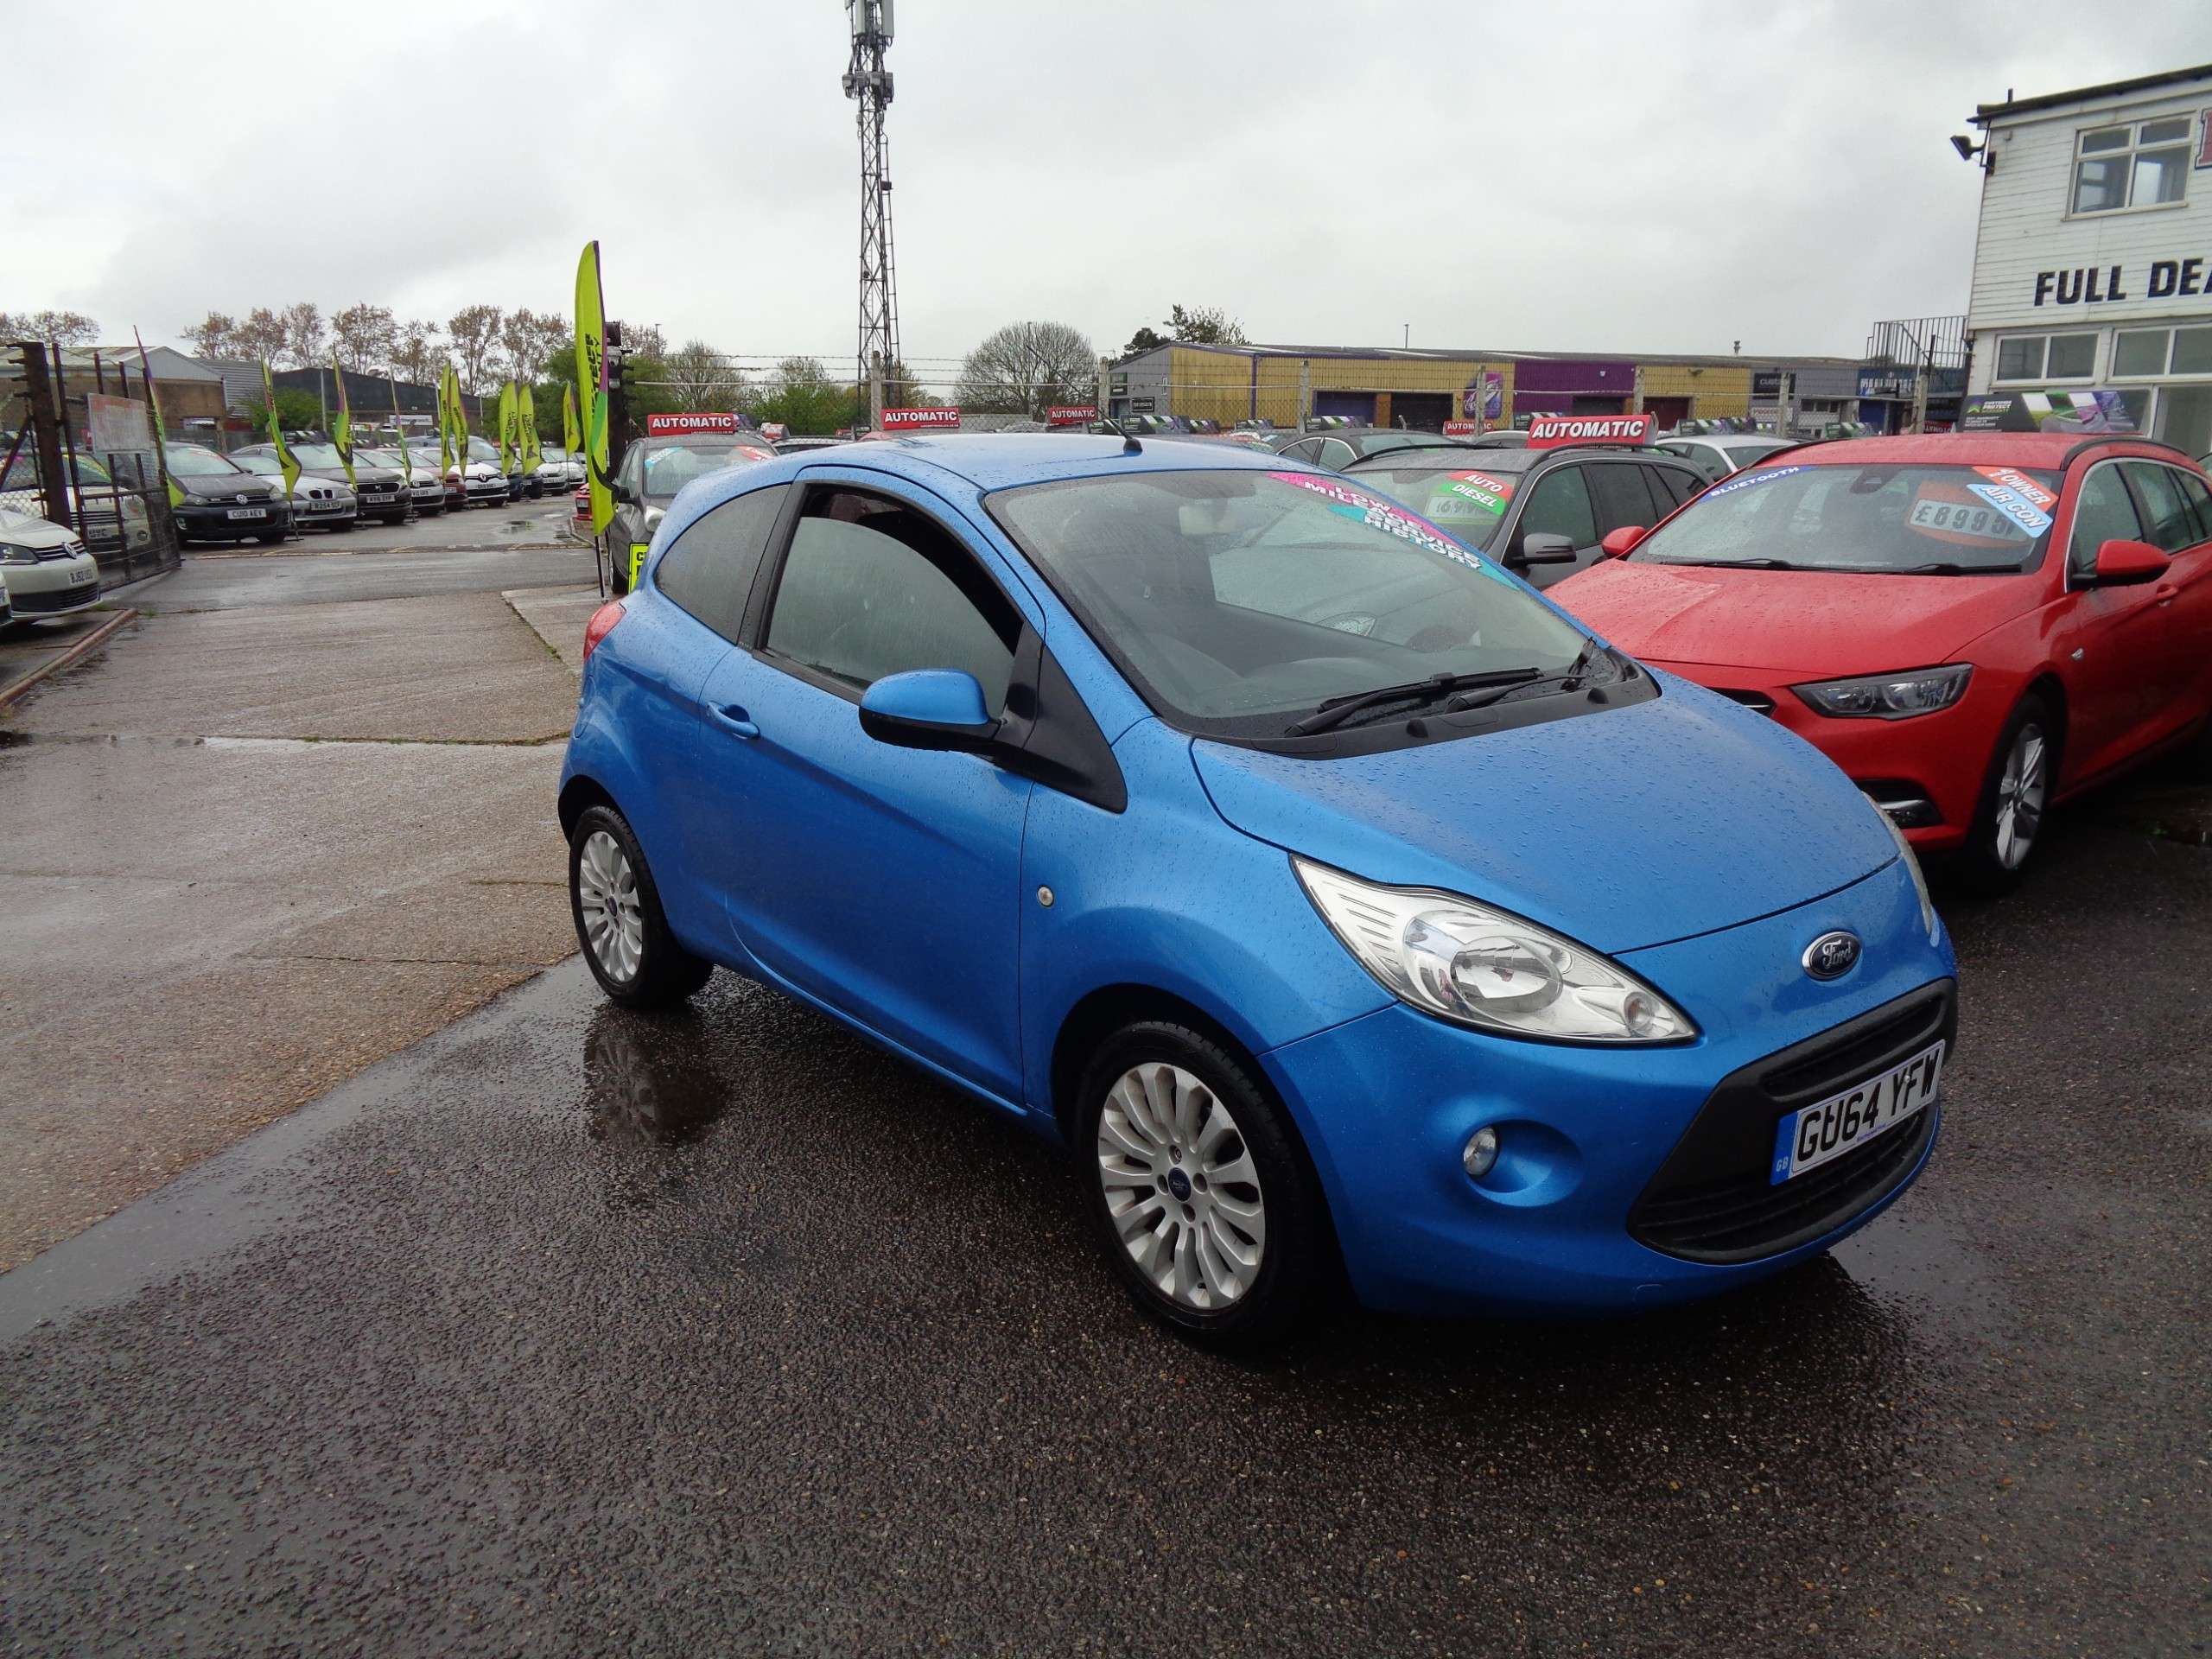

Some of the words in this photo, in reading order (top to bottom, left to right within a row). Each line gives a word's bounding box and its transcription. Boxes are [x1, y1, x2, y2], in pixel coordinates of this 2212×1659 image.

[2034, 265, 2126, 306] FULL
[652, 416, 733, 429] AUTOMATIC
[884, 411, 958, 423] AUTOMATIC
[1052, 410, 1096, 418] AUTOMATIC
[1446, 422, 1493, 430] AUTOMIC
[1531, 420, 1644, 439] AUTOMATIC
[1452, 484, 1497, 507] DIESEL
[1465, 474, 1503, 493] AUTO
[1711, 467, 1799, 497] BLUETOOTH
[2001, 474, 2051, 505] OWNER
[1303, 481, 1424, 531] MILEAGE
[1335, 486, 1392, 512] LOW
[1980, 485, 2014, 505] AIR
[2007, 501, 2047, 529] CON
[1363, 517, 1483, 570] HISTORY
[1364, 510, 1480, 563] SERVICE
[1822, 939, 1853, 969] Ford
[1797, 1081, 1882, 1162] GU64
[1891, 1048, 1940, 1116] YFW
[1776, 1156, 1789, 1173] GB
